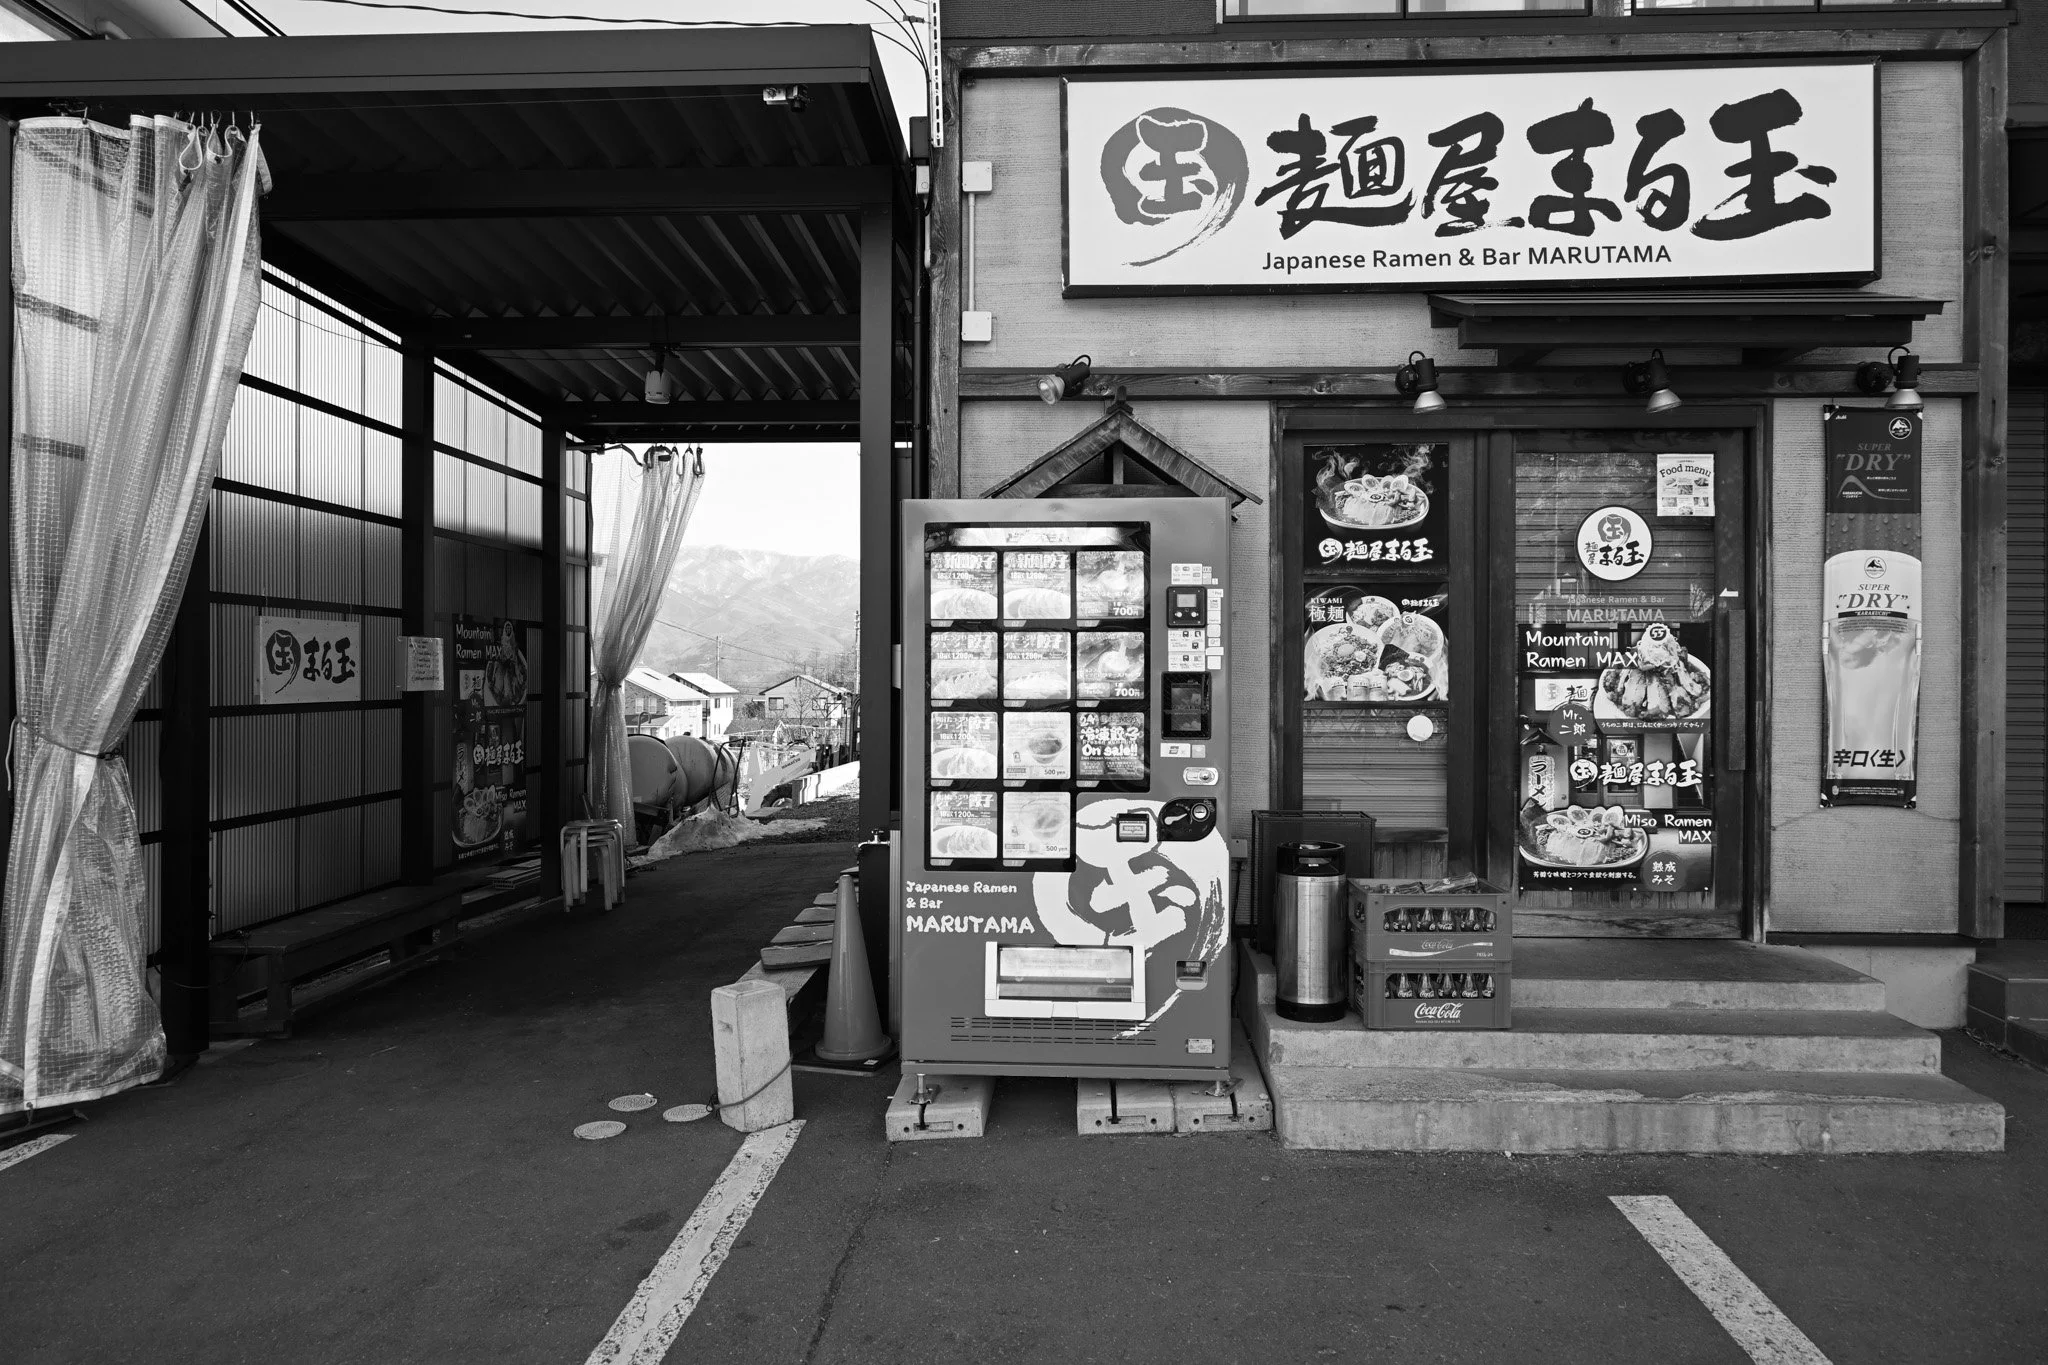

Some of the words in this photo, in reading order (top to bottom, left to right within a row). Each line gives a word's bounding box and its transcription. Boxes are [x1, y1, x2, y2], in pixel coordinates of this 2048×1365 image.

[1263, 253, 1365, 272] Japanese
[1374, 250, 1451, 267] Ramen
[1459, 248, 1474, 265] &
[1483, 248, 1520, 265] Bar
[1529, 245, 1671, 264] MARUTAMA
[1857, 443, 1892, 451] SUPER
[1659, 463, 1684, 479] Food
[1684, 464, 1713, 478] menu
[1858, 583, 1890, 591] SUPER
[1608, 595, 1639, 604] Ramen
[1640, 595, 1647, 603] &
[1650, 595, 1666, 604] Bar
[1308, 604, 1345, 623] 極麺
[1566, 608, 1665, 623] MARUTAMA
[455, 623, 491, 641] Mountain
[1526, 631, 1610, 646] Mountain
[455, 643, 482, 660] Ramen
[303, 636, 356, 684] まる玉
[1526, 652, 1586, 668] Ramen
[1596, 651, 1638, 667] MAX
[1562, 709, 1583, 720] Mr.
[1559, 723, 1586, 736] 二郎
[1082, 744, 1101, 756] On
[1624, 814, 1657, 827] Miso
[1664, 814, 1712, 827] Ramen
[1678, 831, 1712, 843] MAX
[1651, 874, 1674, 885] みそ
[906, 881, 969, 893] Japanese
[974, 882, 1017, 893] Ramen
[906, 898, 916, 908] &
[920, 898, 943, 908] Bar
[907, 915, 1035, 933] MARUTAMA
[1414, 1002, 1464, 1019] Coca-Cola
